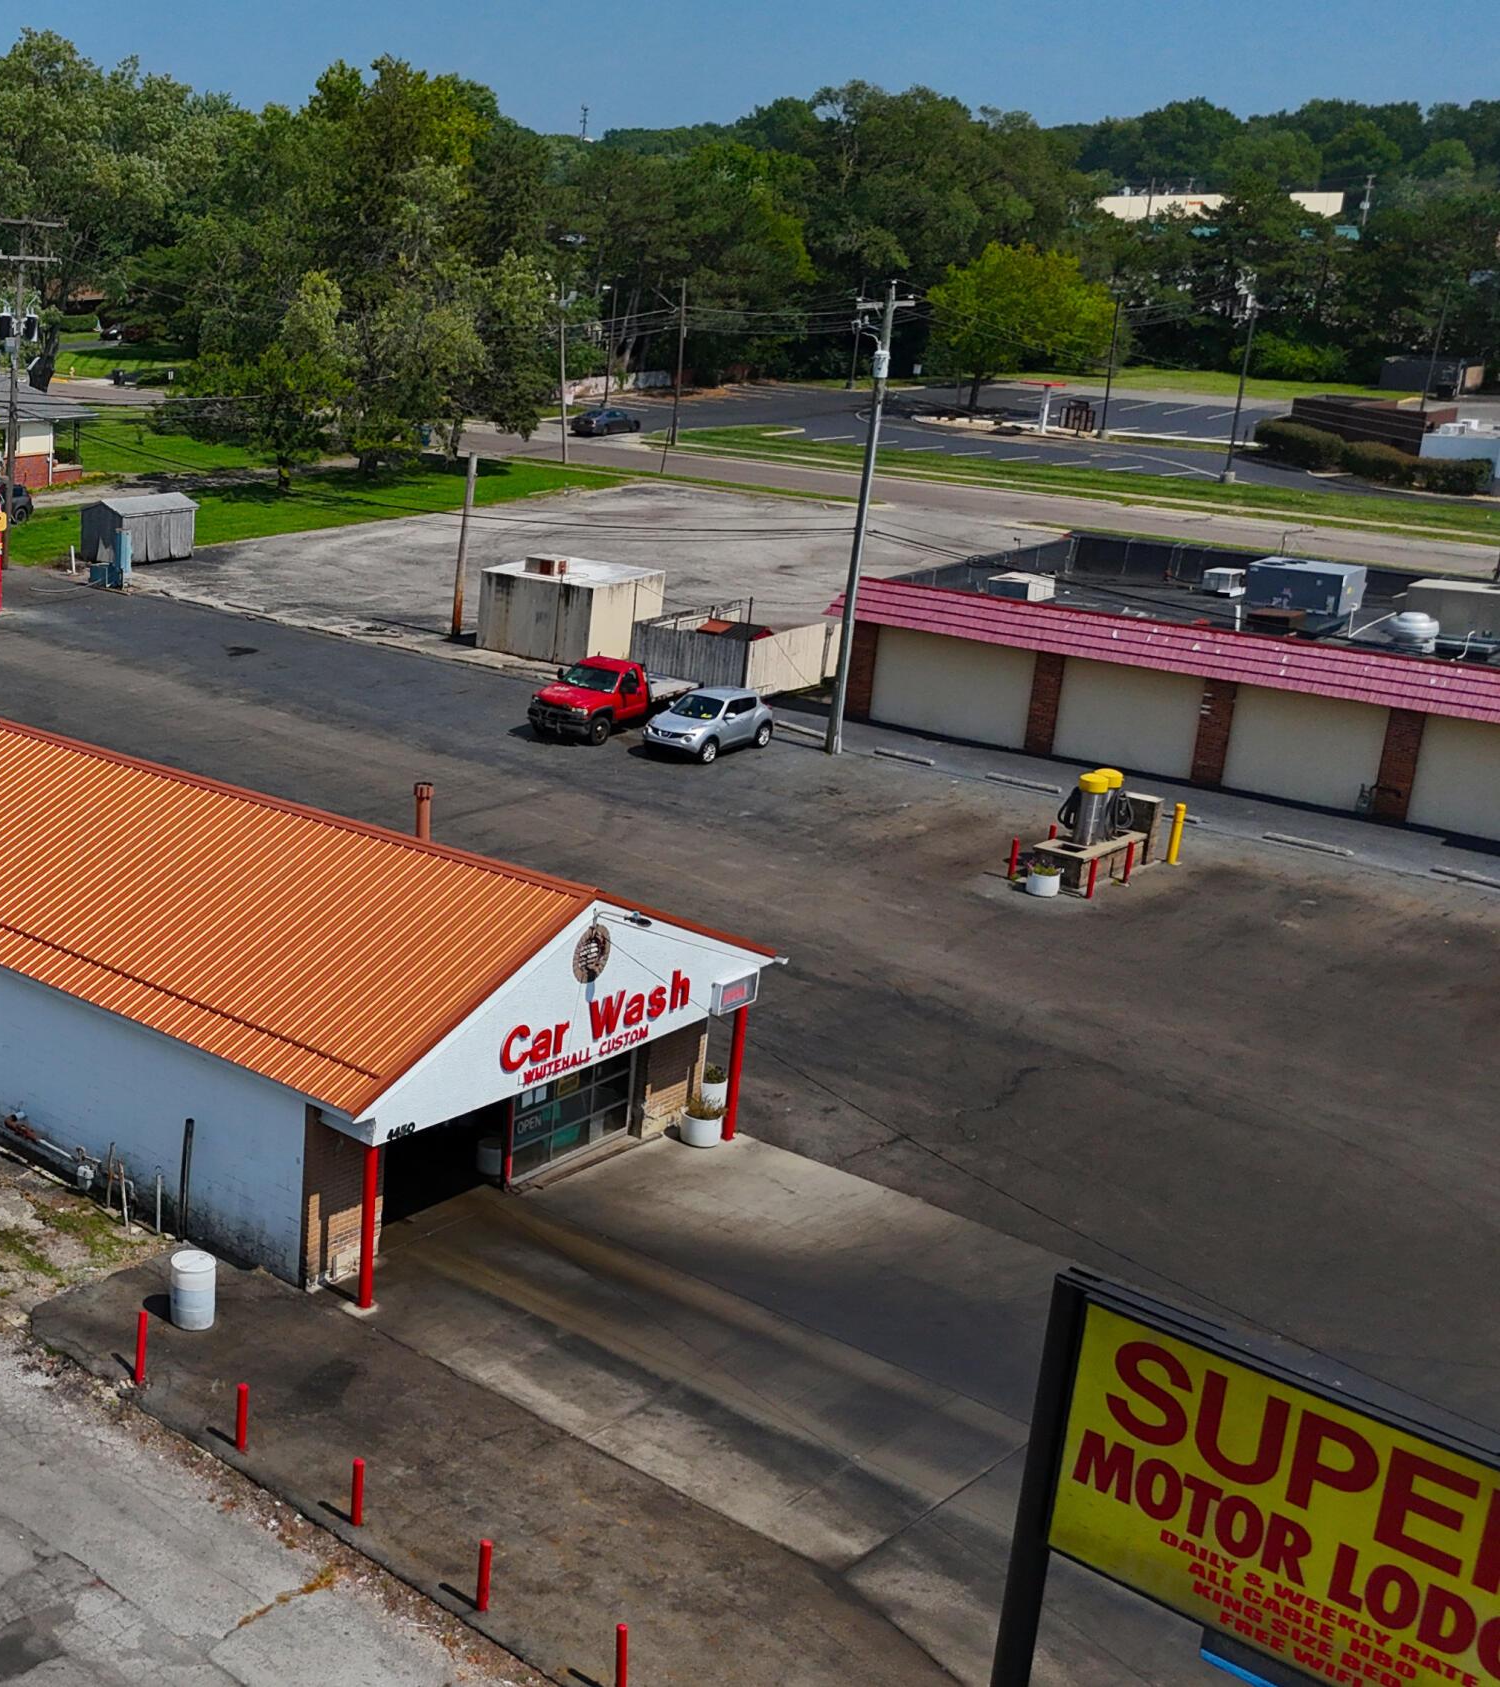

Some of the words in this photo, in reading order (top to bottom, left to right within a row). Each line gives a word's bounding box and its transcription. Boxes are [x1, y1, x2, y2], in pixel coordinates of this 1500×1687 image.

[500, 1020, 570, 1073] Car
[589, 968, 691, 1041] Wash
[522, 1047, 592, 1086] WHITEHALL
[599, 1024, 649, 1056] CUSTOM
[387, 1121, 416, 1141] 4450
[516, 1113, 542, 1135] OPEN
[1072, 1429, 1313, 1588] MOTOR
[1106, 1341, 1500, 1595] SUPE
[1160, 1529, 1238, 1575] DAILY
[1244, 1571, 1266, 1589] &
[1273, 1582, 1393, 1647] WEEKLY
[1188, 1561, 1233, 1592] ALL
[1242, 1587, 1335, 1639] CABLE
[1350, 1637, 1417, 1680] HBO
[1192, 1580, 1263, 1623] KING
[1270, 1620, 1334, 1659] SIZE
[1219, 1611, 1285, 1653] FREE
[1293, 1647, 1363, 1687] WIFI
